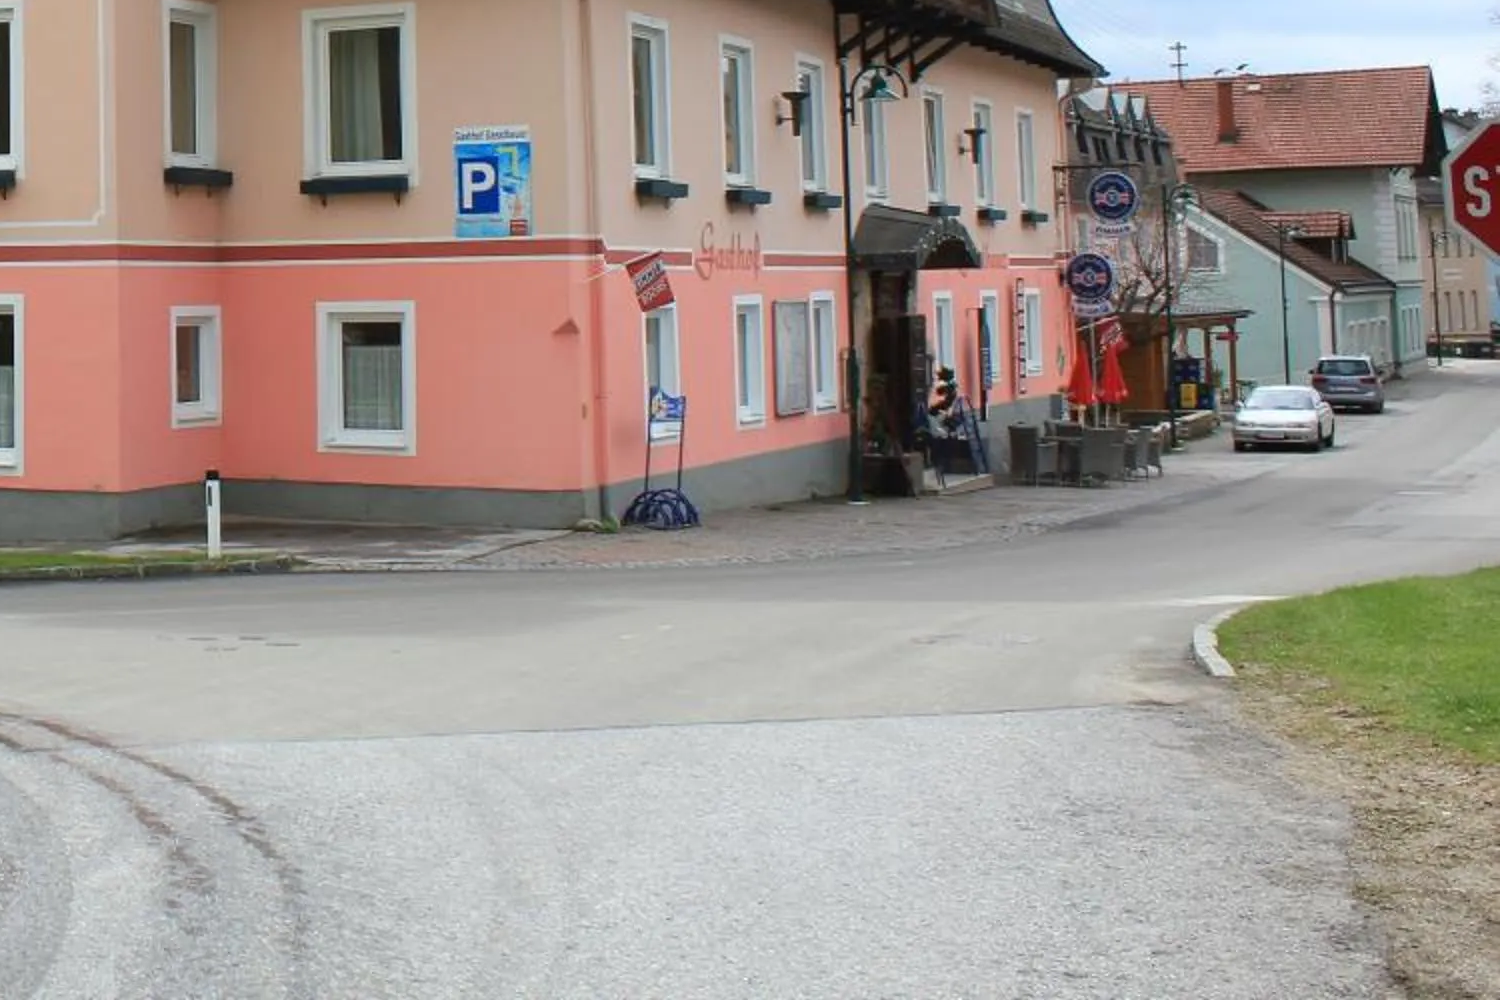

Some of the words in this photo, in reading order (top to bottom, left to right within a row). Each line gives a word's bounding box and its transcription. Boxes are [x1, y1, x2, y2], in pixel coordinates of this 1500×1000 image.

[461, 162, 496, 208] P
[1463, 165, 1500, 217] S
[695, 221, 761, 280] Gasthof
